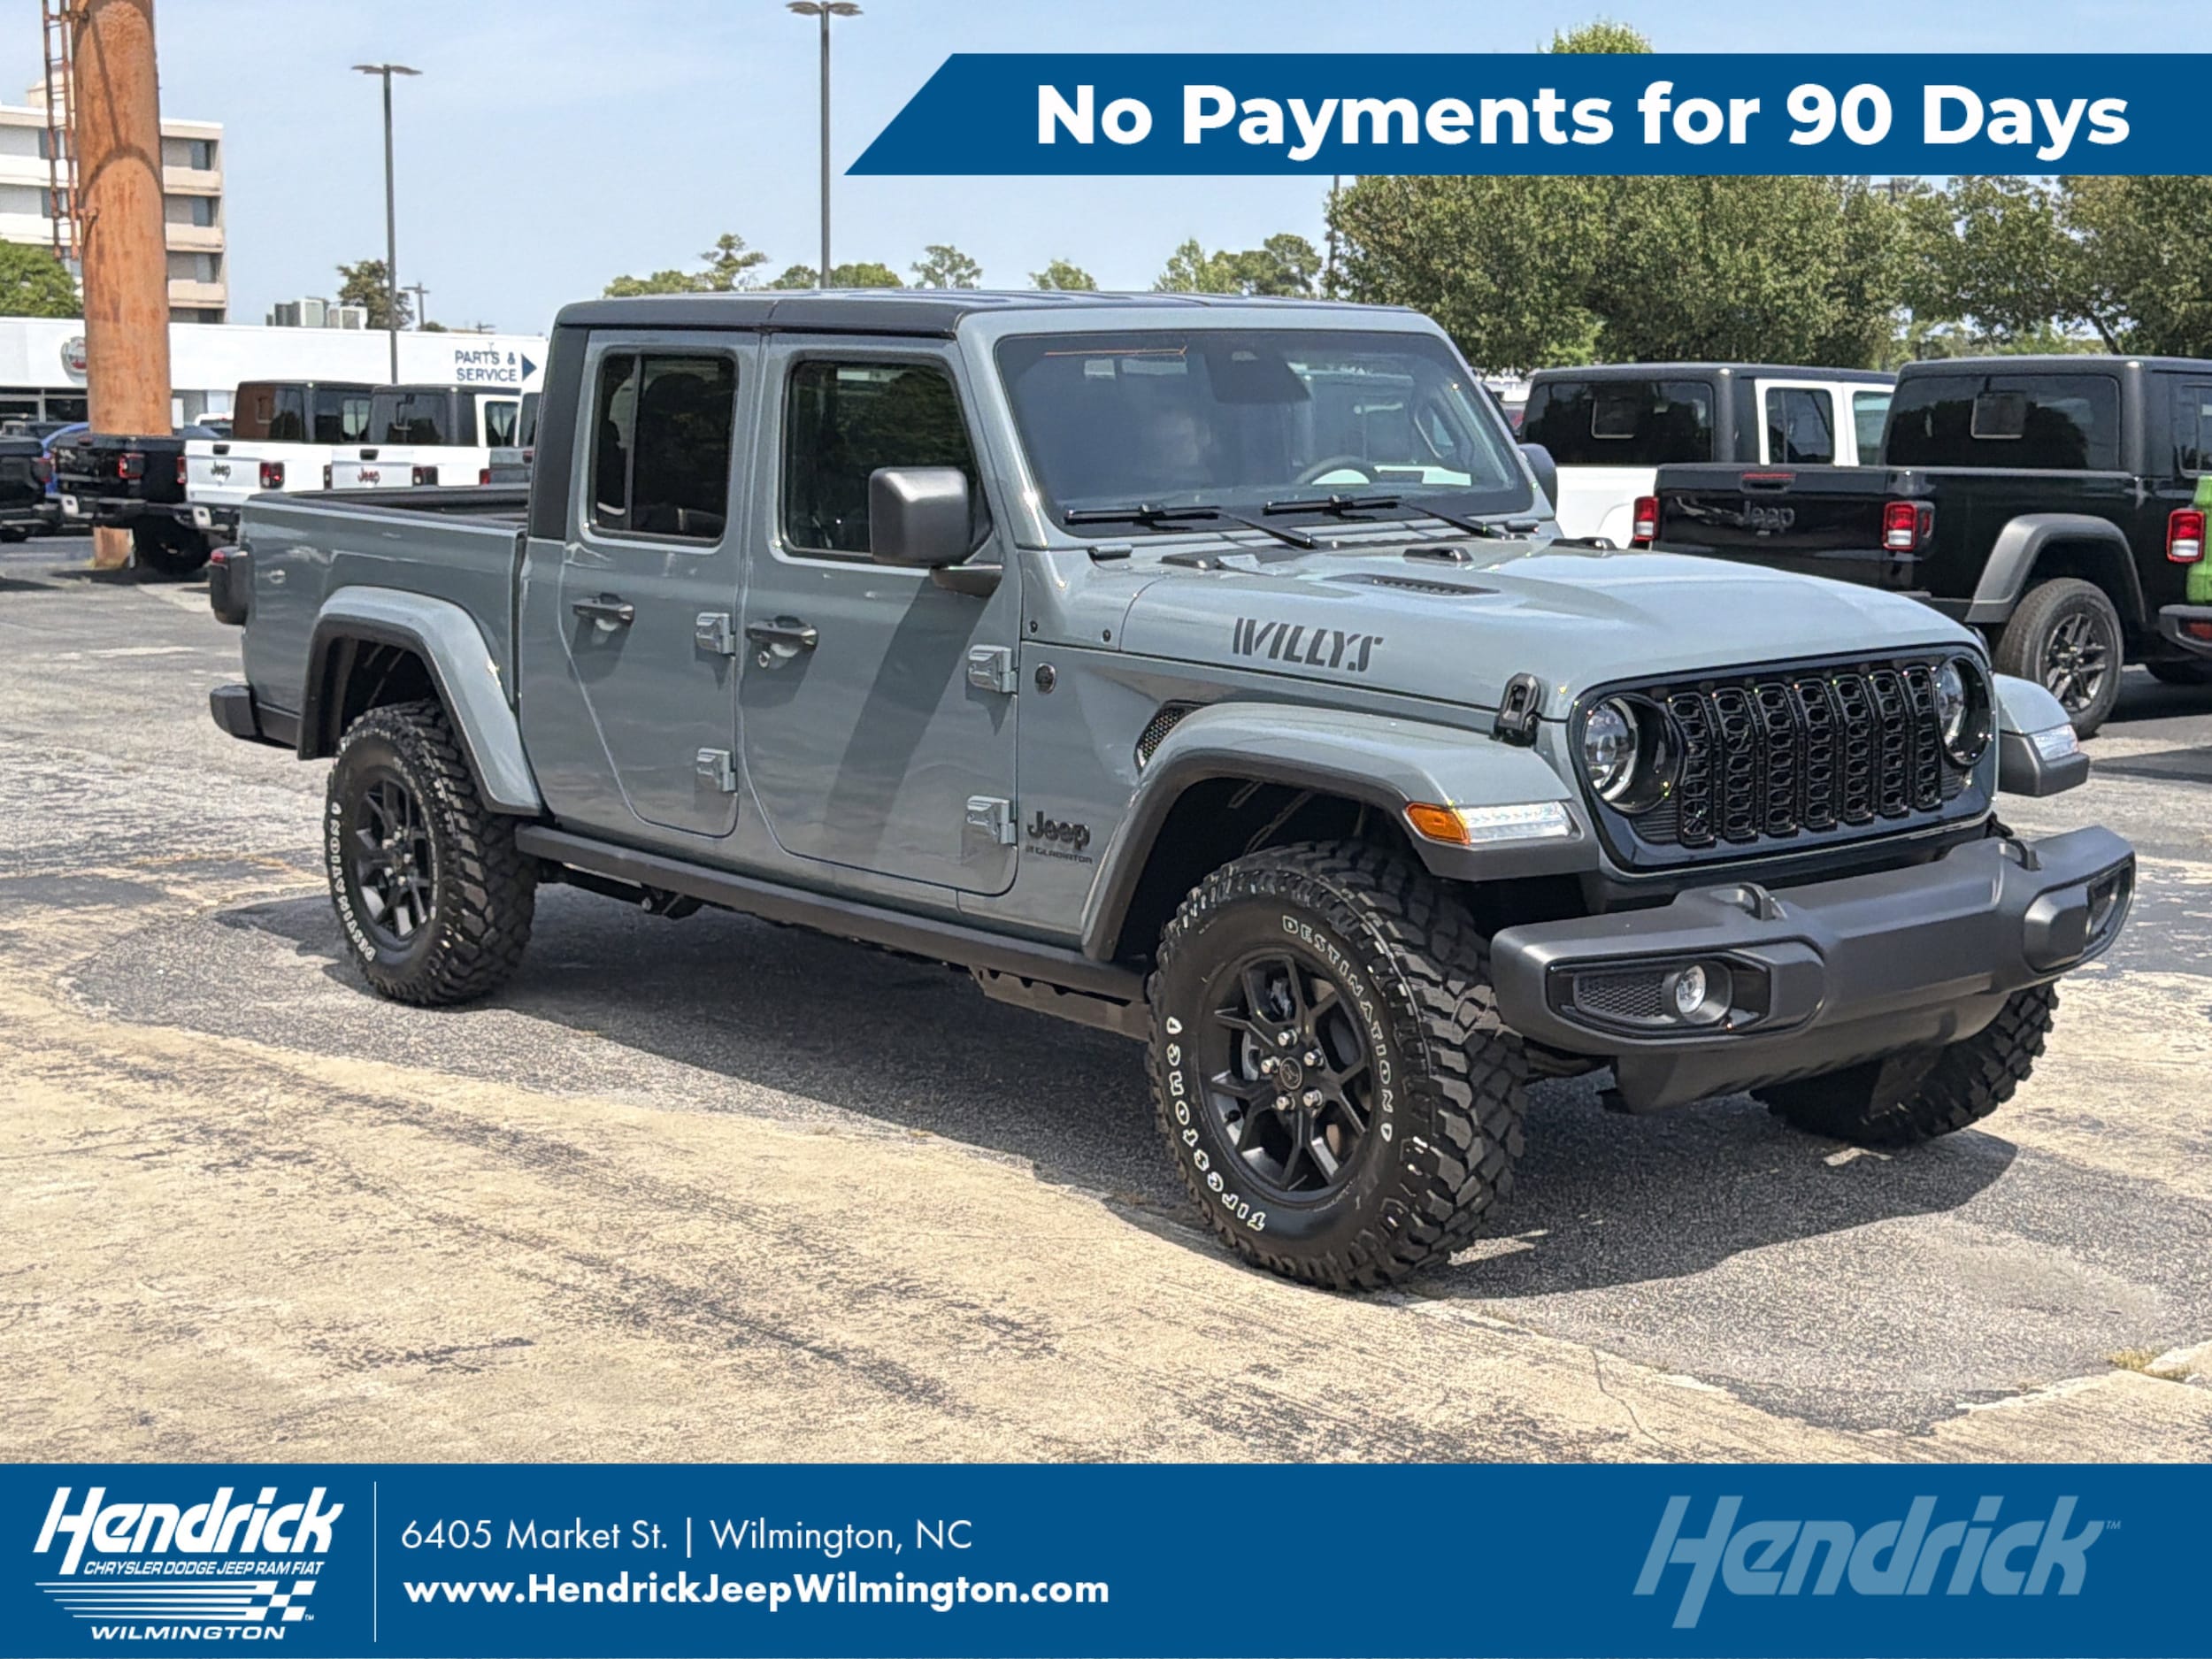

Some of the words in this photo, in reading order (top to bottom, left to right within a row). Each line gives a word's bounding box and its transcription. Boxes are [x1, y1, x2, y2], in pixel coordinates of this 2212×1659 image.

[455, 349, 500, 365] PARTS
[507, 351, 516, 365] &
[456, 367, 517, 382] SERVICE
[211, 461, 231, 478] Jeep
[357, 467, 380, 484] Jeep
[1738, 500, 1794, 532] Jeep
[1232, 616, 1384, 673] WILLYS
[1025, 810, 1091, 851] Jeep
[1035, 846, 1094, 864] GLADIATOR
[1281, 914, 1394, 1113] DESTINATION
